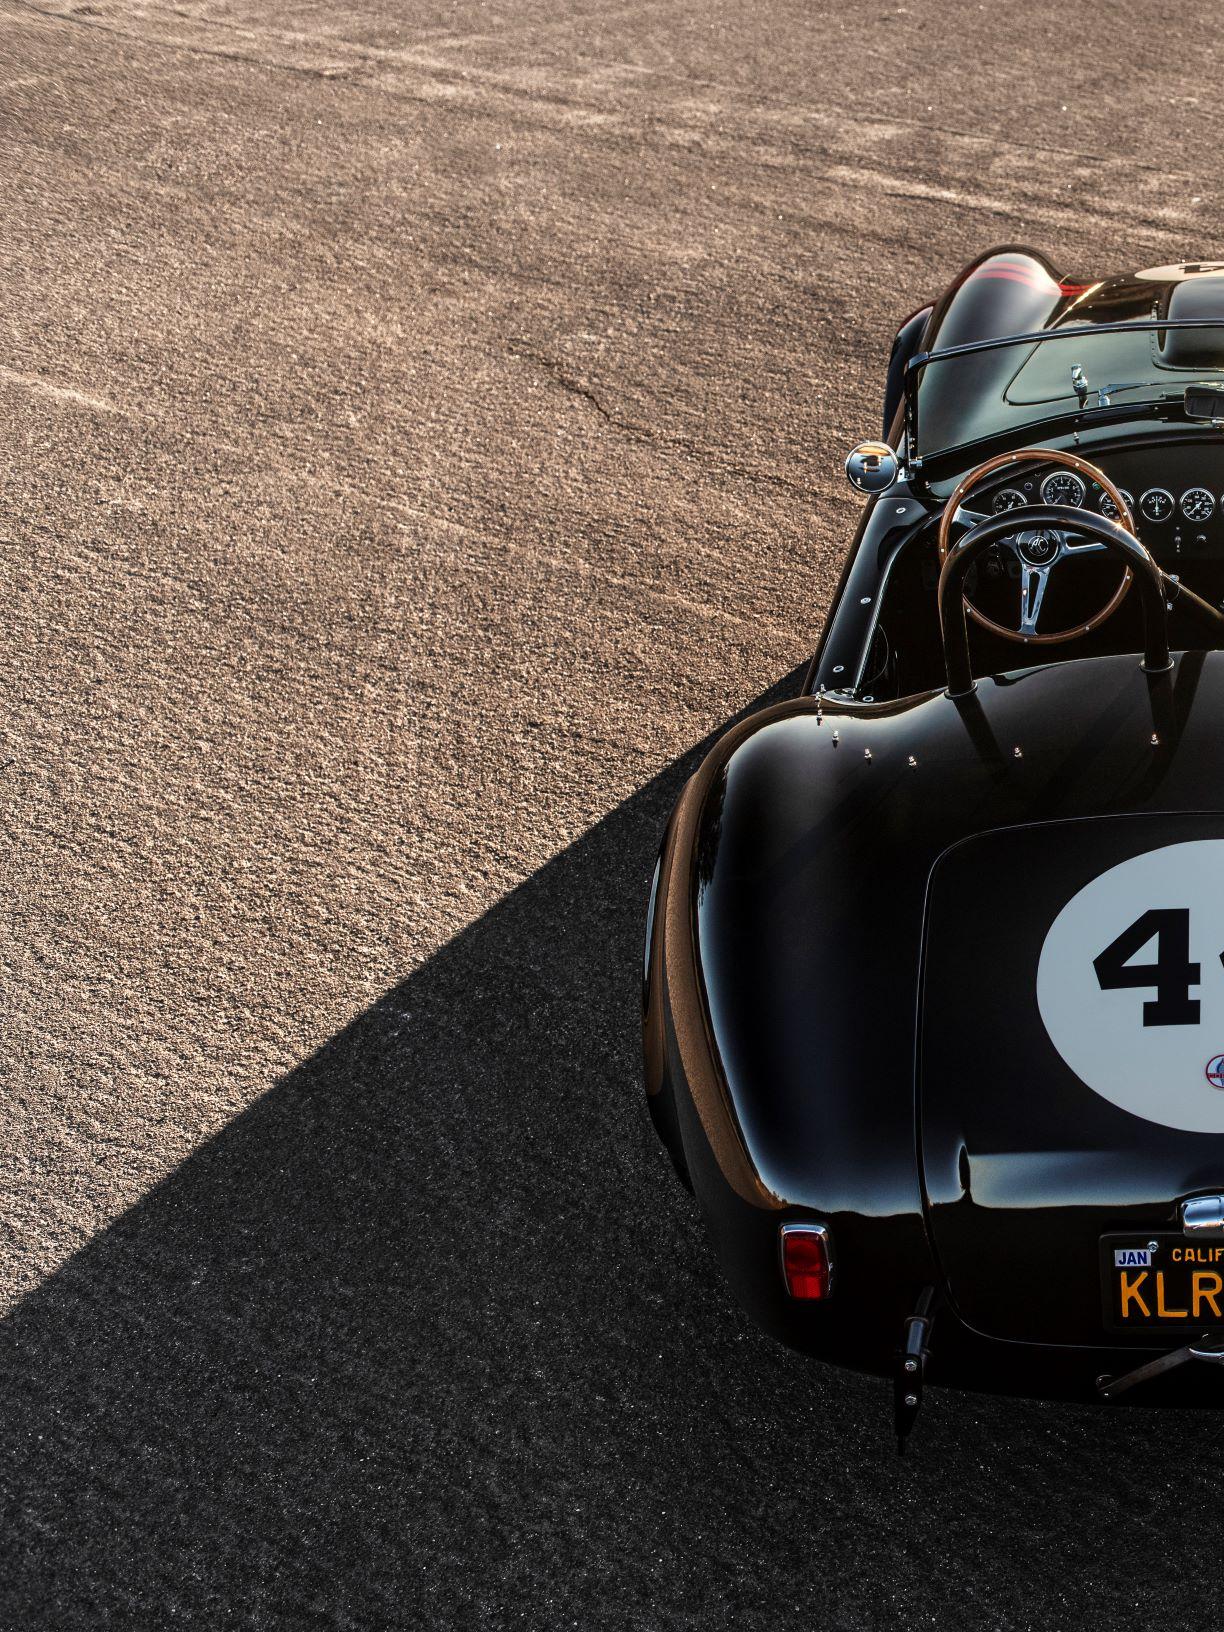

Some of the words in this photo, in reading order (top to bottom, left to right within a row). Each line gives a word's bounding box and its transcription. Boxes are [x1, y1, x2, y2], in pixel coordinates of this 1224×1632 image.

[1030, 537, 1047, 552] AC
[1118, 1251, 1148, 1265] JAN
[1120, 1270, 1223, 1318] KLR
